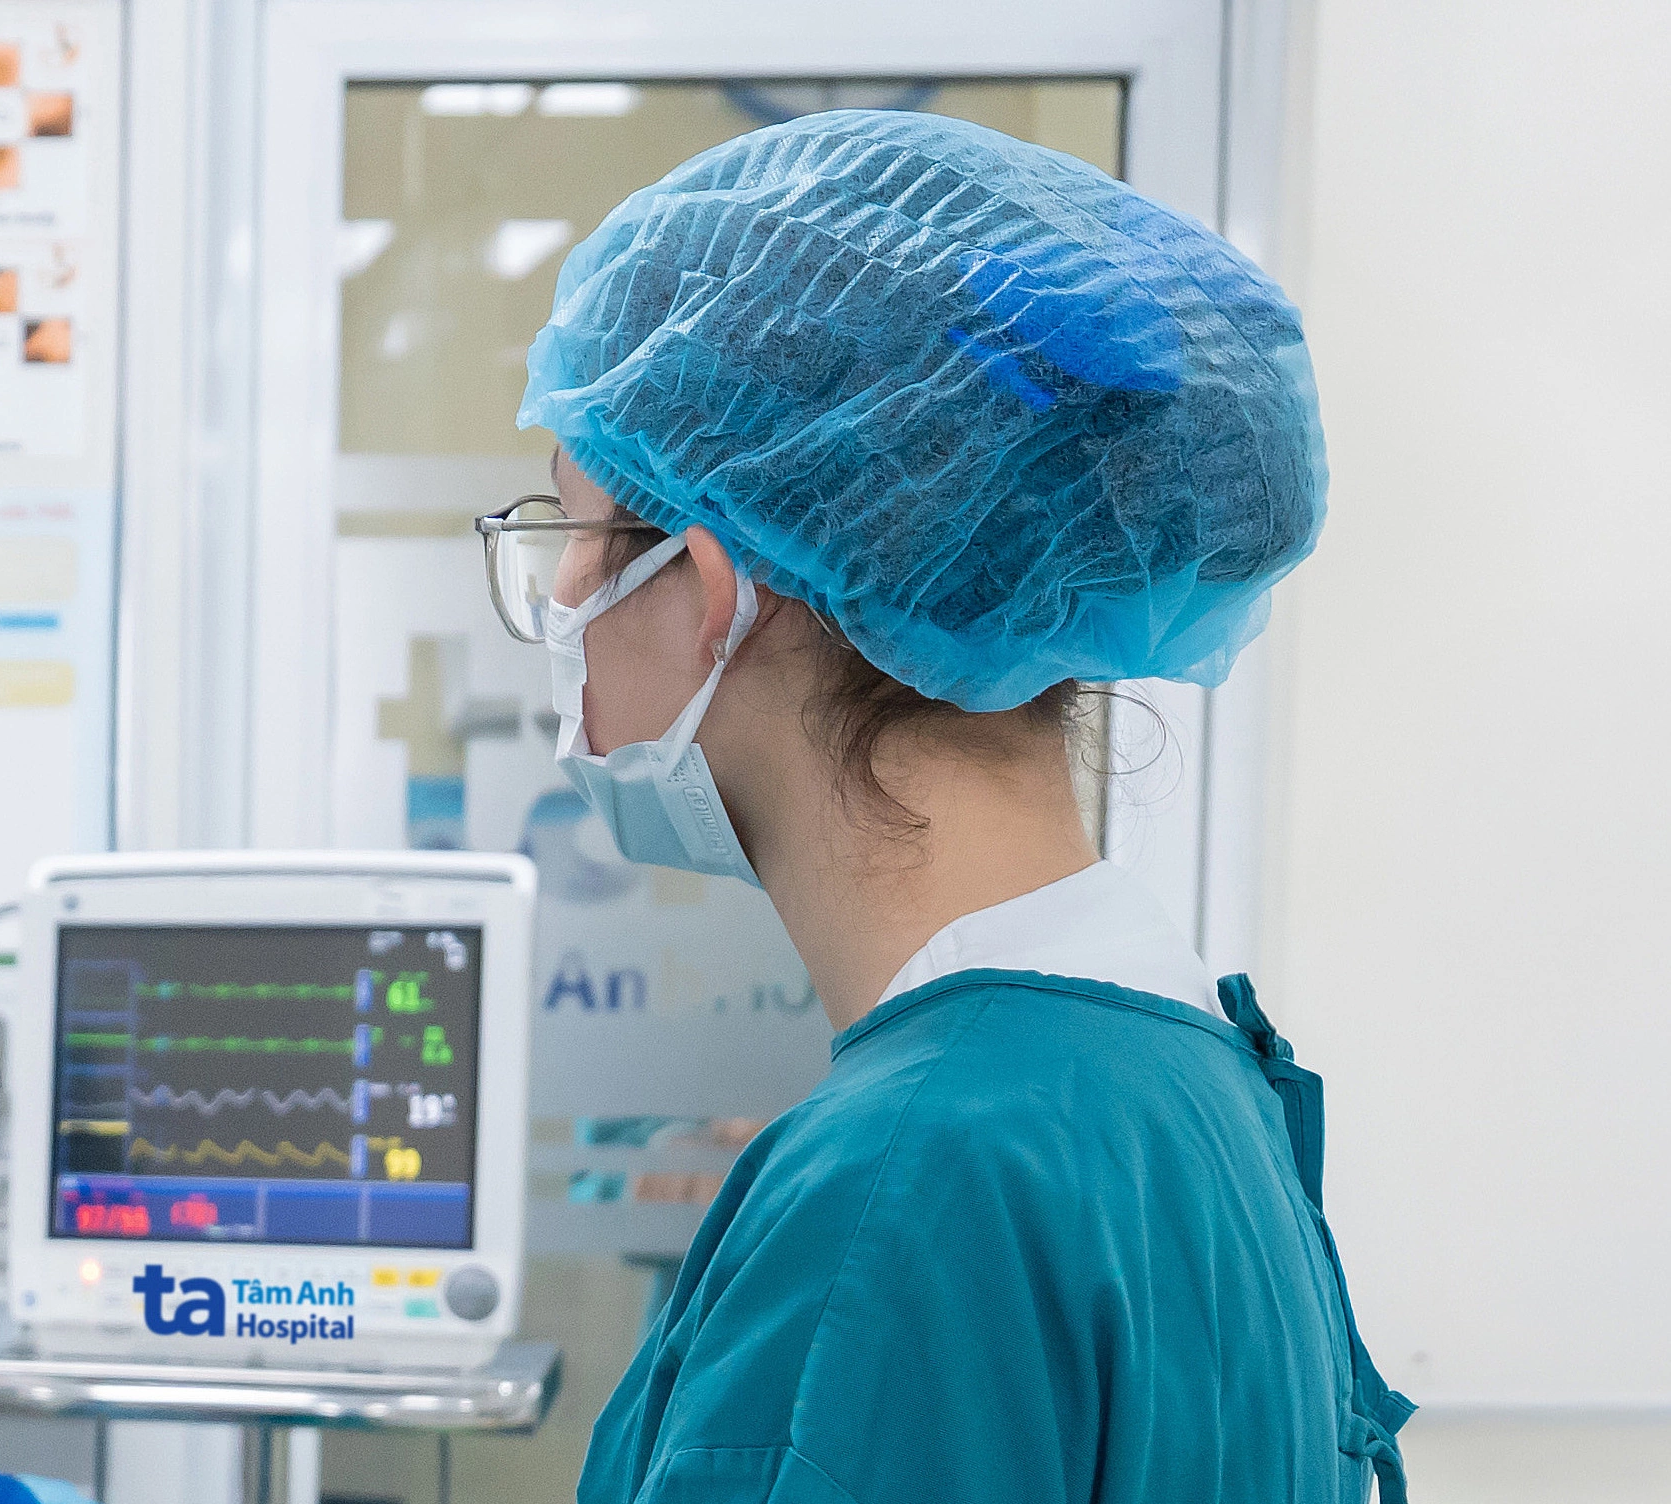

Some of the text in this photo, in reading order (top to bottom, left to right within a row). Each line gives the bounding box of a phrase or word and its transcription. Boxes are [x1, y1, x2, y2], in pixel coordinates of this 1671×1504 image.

[133, 1264, 226, 1337] ta
[232, 1279, 354, 1306] Tâm Anh
[237, 1312, 354, 1345] Hospital
